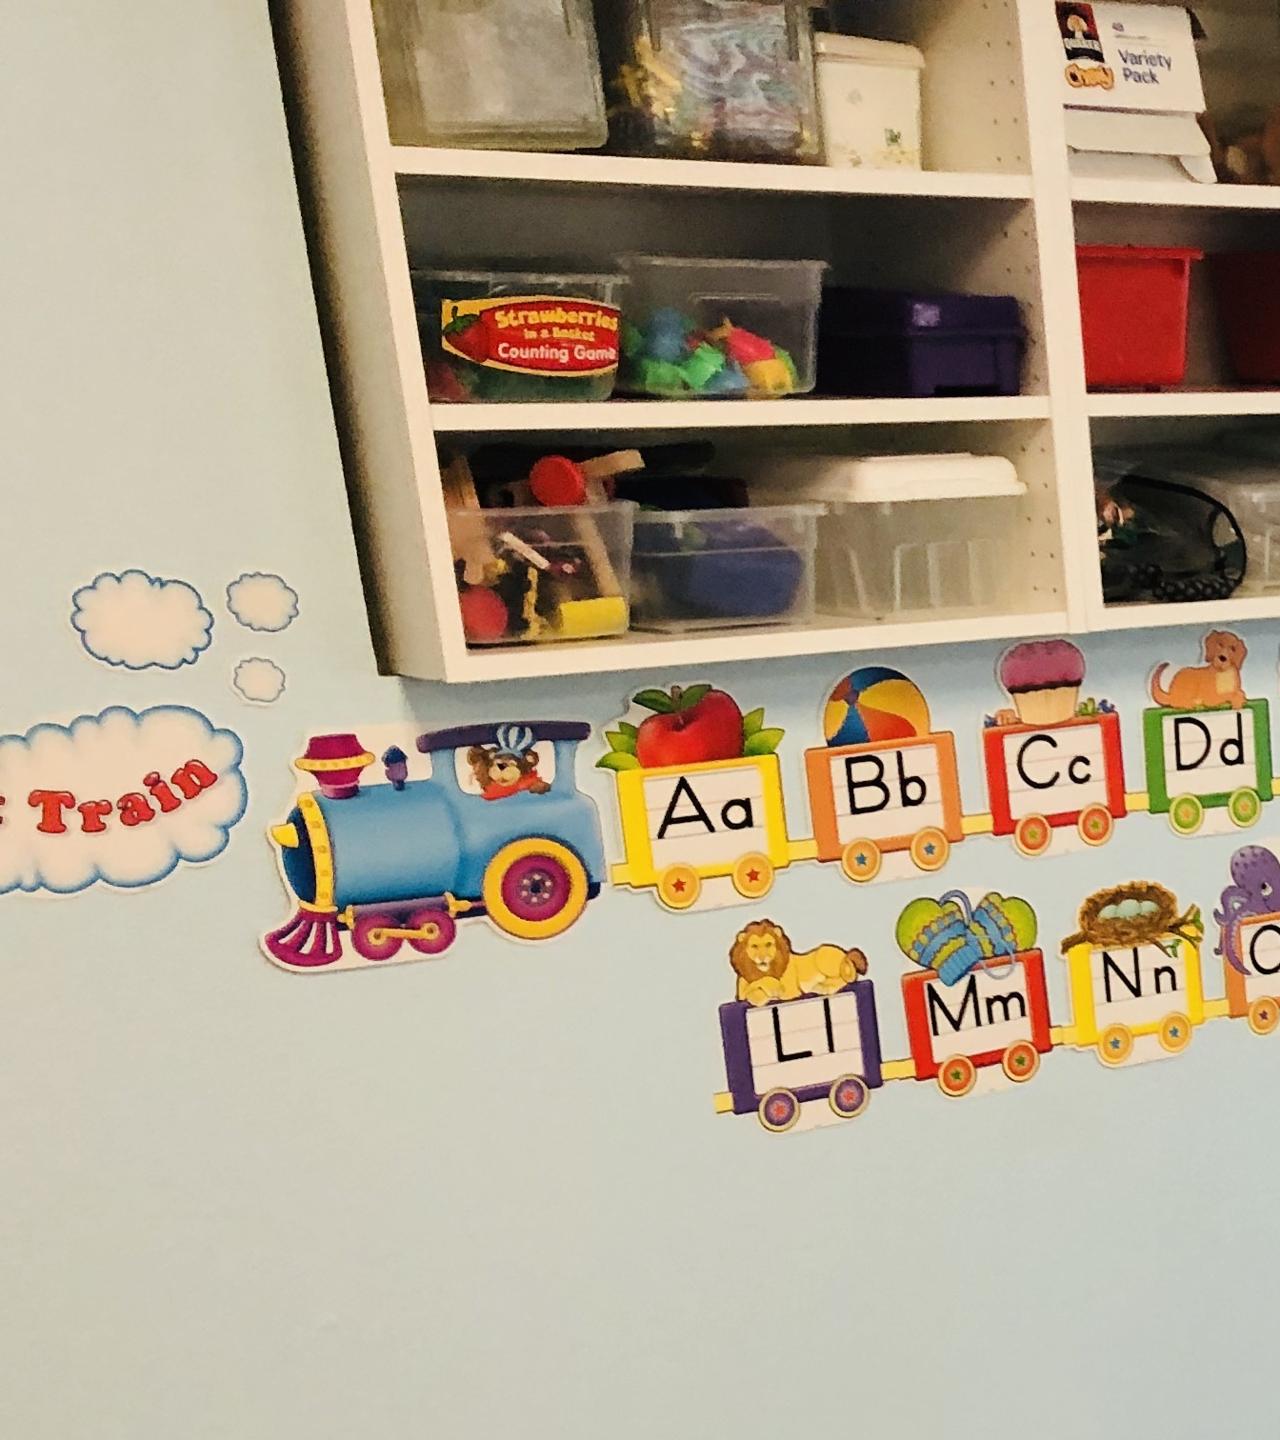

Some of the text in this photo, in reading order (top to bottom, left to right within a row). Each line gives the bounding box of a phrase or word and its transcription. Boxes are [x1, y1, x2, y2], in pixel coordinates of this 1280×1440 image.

[1118, 48, 1172, 71] Variety
[1122, 67, 1160, 85] Pack
[494, 307, 619, 331] Strawberries
[497, 342, 618, 363] Counting Game
[657, 776, 754, 839] Aa
[844, 751, 928, 815] Bb
[1016, 735, 1091, 790] Cc
[1173, 712, 1245, 771] Dd
[27, 758, 218, 834] Train
[927, 975, 1027, 1036] Mm
[1102, 946, 1178, 1002] Nn
